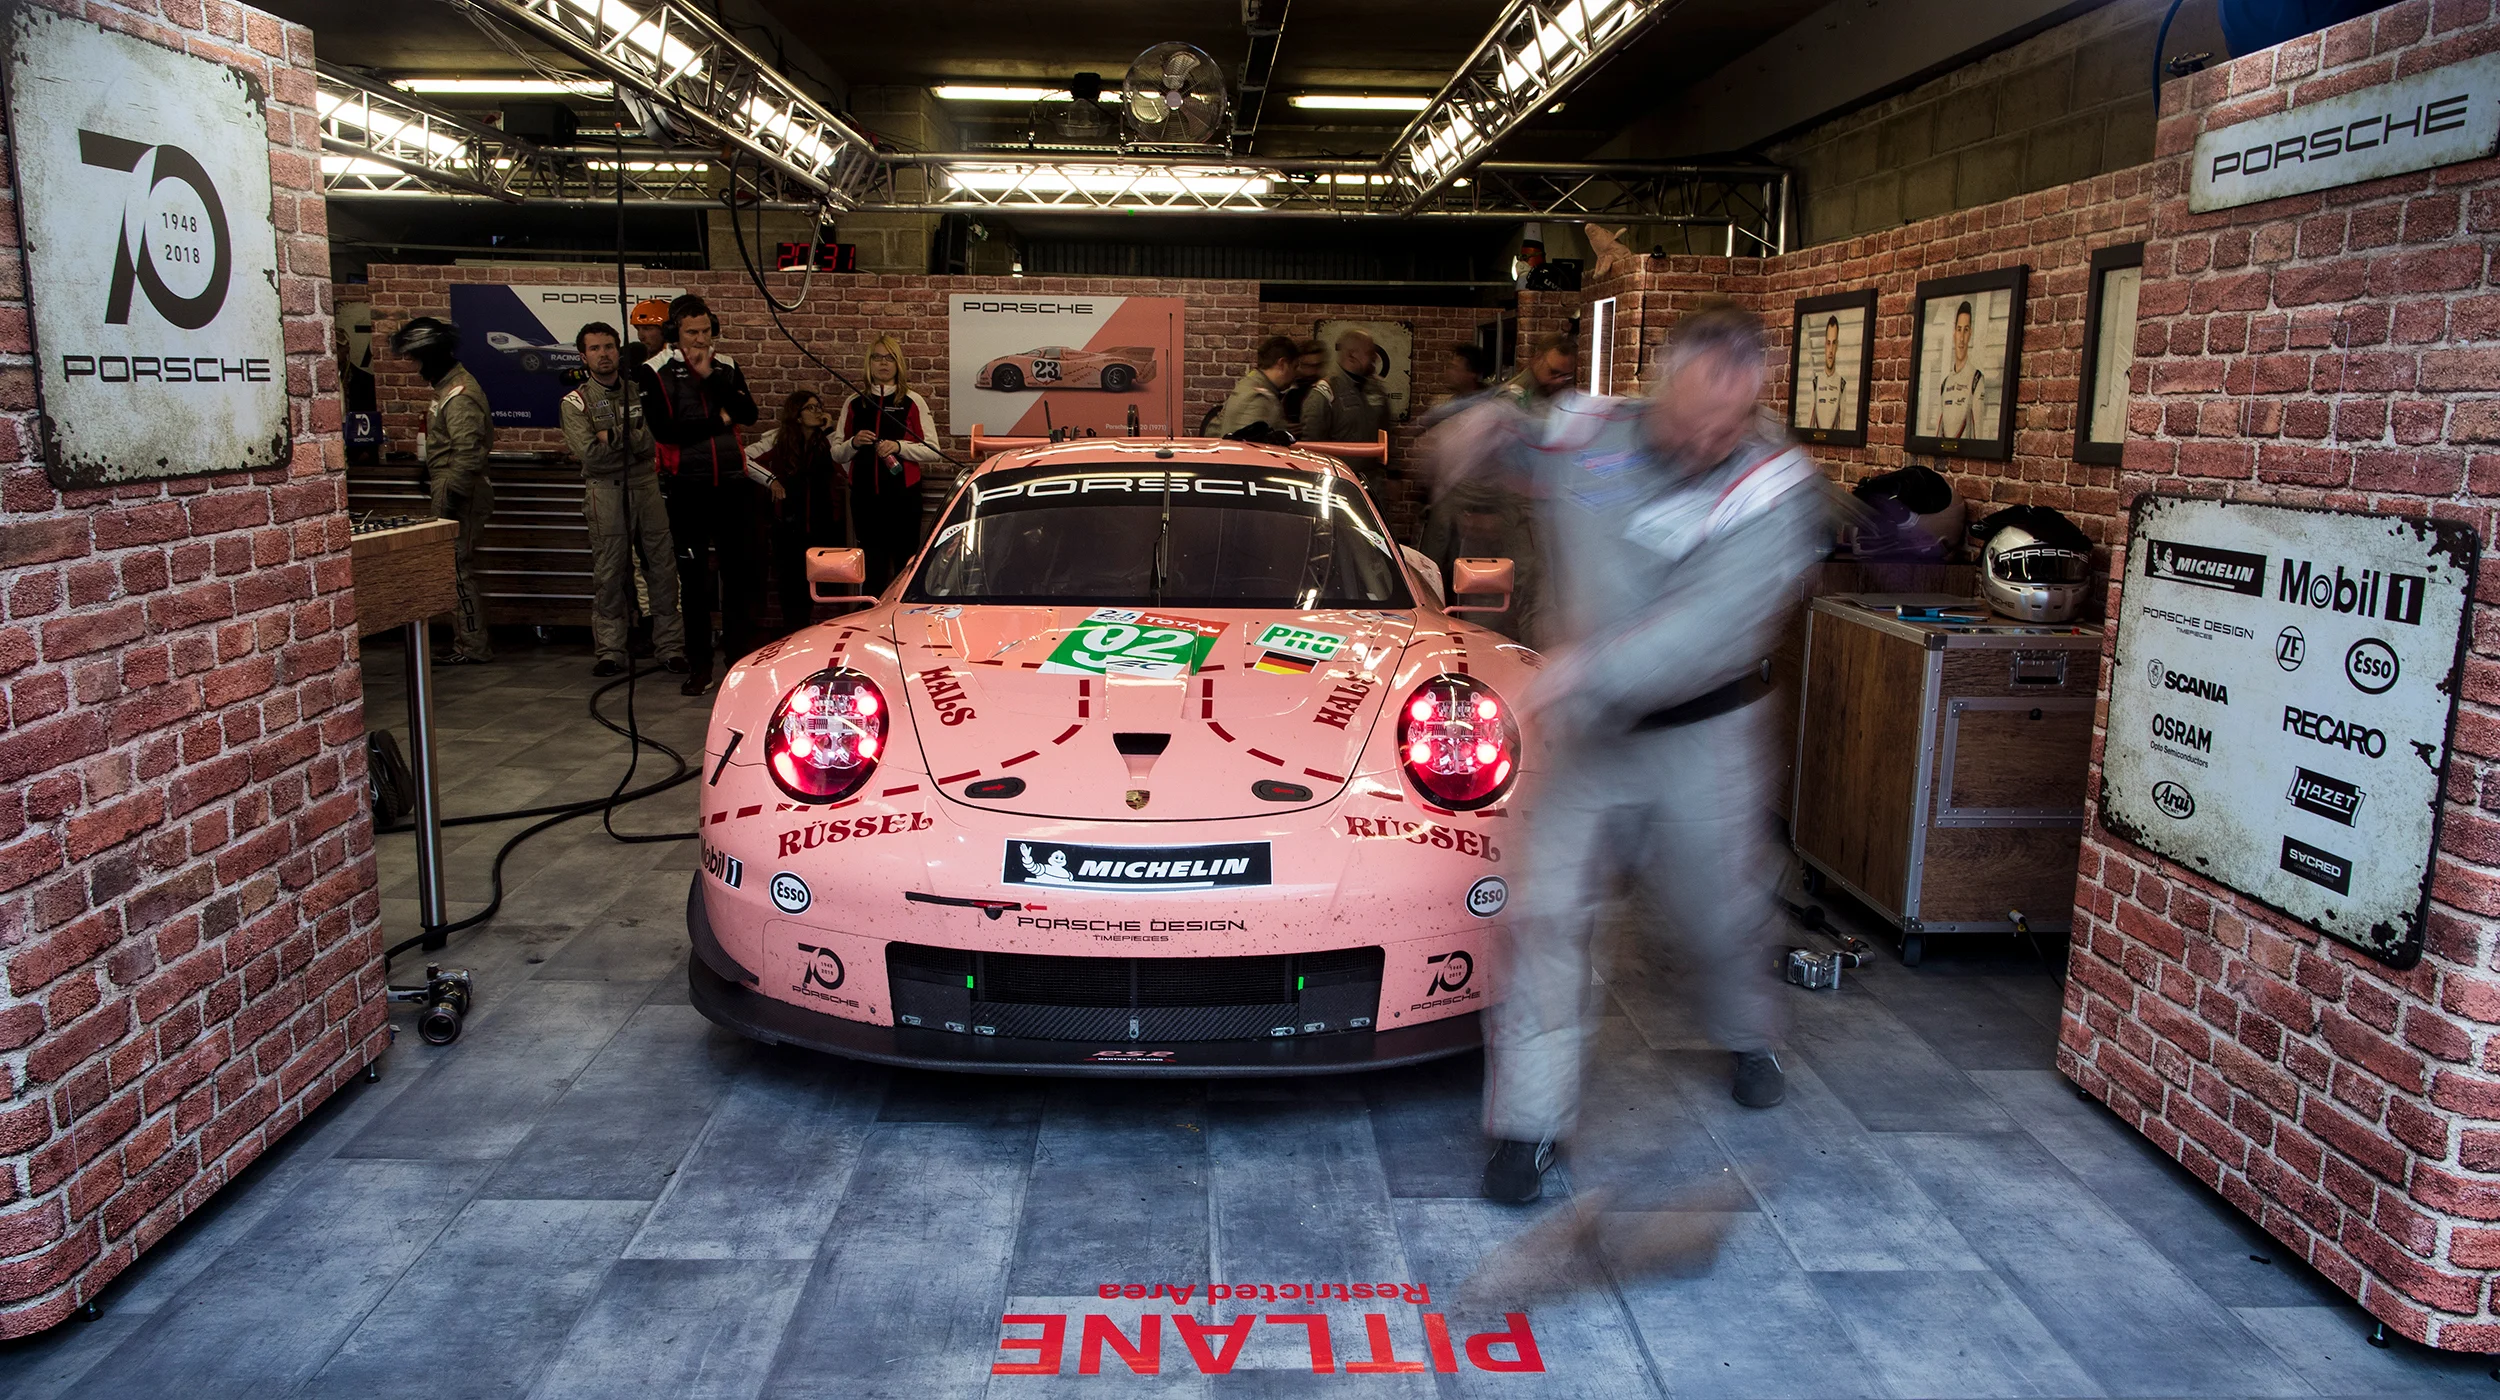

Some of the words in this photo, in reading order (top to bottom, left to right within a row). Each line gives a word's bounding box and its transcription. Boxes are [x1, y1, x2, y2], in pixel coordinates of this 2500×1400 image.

[2211, 94, 2469, 183] PORSCHE
[78, 128, 232, 330] 70
[162, 212, 198, 233] 1948
[165, 244, 200, 264] 2018
[963, 302, 1093, 314] PORSCHE
[62, 355, 271, 383] PORSCHE
[551, 354, 581, 362] RACING
[1034, 360, 1060, 380] 23
[1149, 424, 1167, 433] (1971)
[974, 477, 1351, 509] PORSCHE
[1999, 548, 2089, 564] PORSCHE
[2176, 556, 2255, 583] MICHELIN
[2279, 558, 2380, 619] Mobil
[1145, 616, 1220, 633] TOTAL
[2142, 606, 2201, 628] PORSCHE
[2204, 619, 2255, 640] DESIGN
[1072, 624, 1195, 669] 92
[1262, 626, 1342, 655] PRO
[2279, 633, 2306, 664] ZF
[918, 665, 977, 727] HALS
[2164, 670, 2229, 706] SCANIA
[2152, 713, 2213, 754] OSRAM
[2282, 705, 2387, 759] RECARO
[2150, 740, 2163, 753] Opto
[2163, 745, 2209, 769] Semiconductors
[2155, 784, 2190, 813] Arai
[2295, 778, 2356, 809] HAZET
[777, 811, 933, 860] RÜSSEL
[1344, 815, 1501, 863] RÜSSEL
[1078, 857, 1250, 878] MICHELIN
[1017, 916, 1141, 932] PORSCHE
[1150, 919, 1245, 932] DESIGN
[1093, 934, 1169, 942] TIMEPIECES
[798, 942, 845, 990] 70
[1426, 950, 1473, 997] 70
[792, 985, 859, 1008] PORSCHE
[1410, 990, 1481, 1012] PORSCHE
[1099, 1283, 1196, 1306] Area
[1205, 1283, 1432, 1306] Restricted
[992, 1312, 1547, 1375] PITLANE
